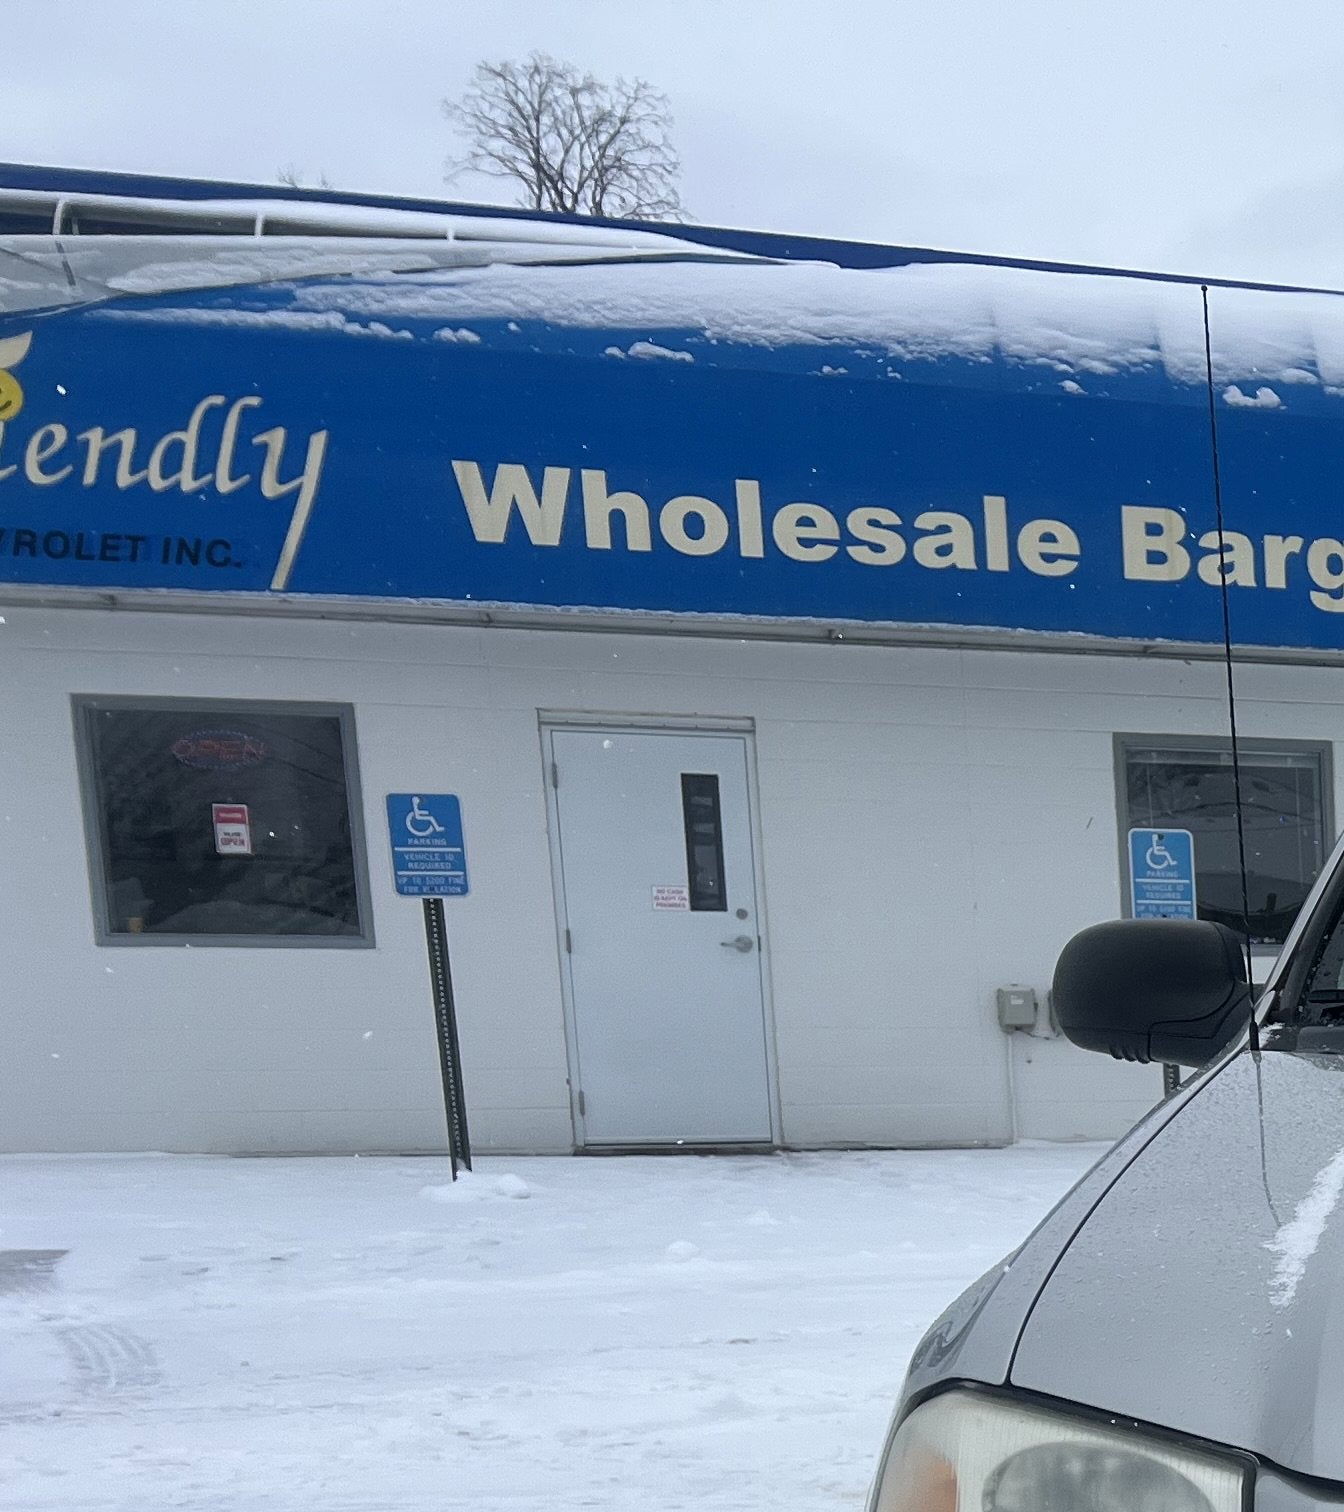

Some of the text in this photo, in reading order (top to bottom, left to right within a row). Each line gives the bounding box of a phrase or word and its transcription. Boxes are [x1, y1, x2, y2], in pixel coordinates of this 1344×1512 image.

[451, 459, 1081, 577] Wholesale
[0, 525, 243, 569] ROLET INC.
[407, 838, 447, 846] PARKING
